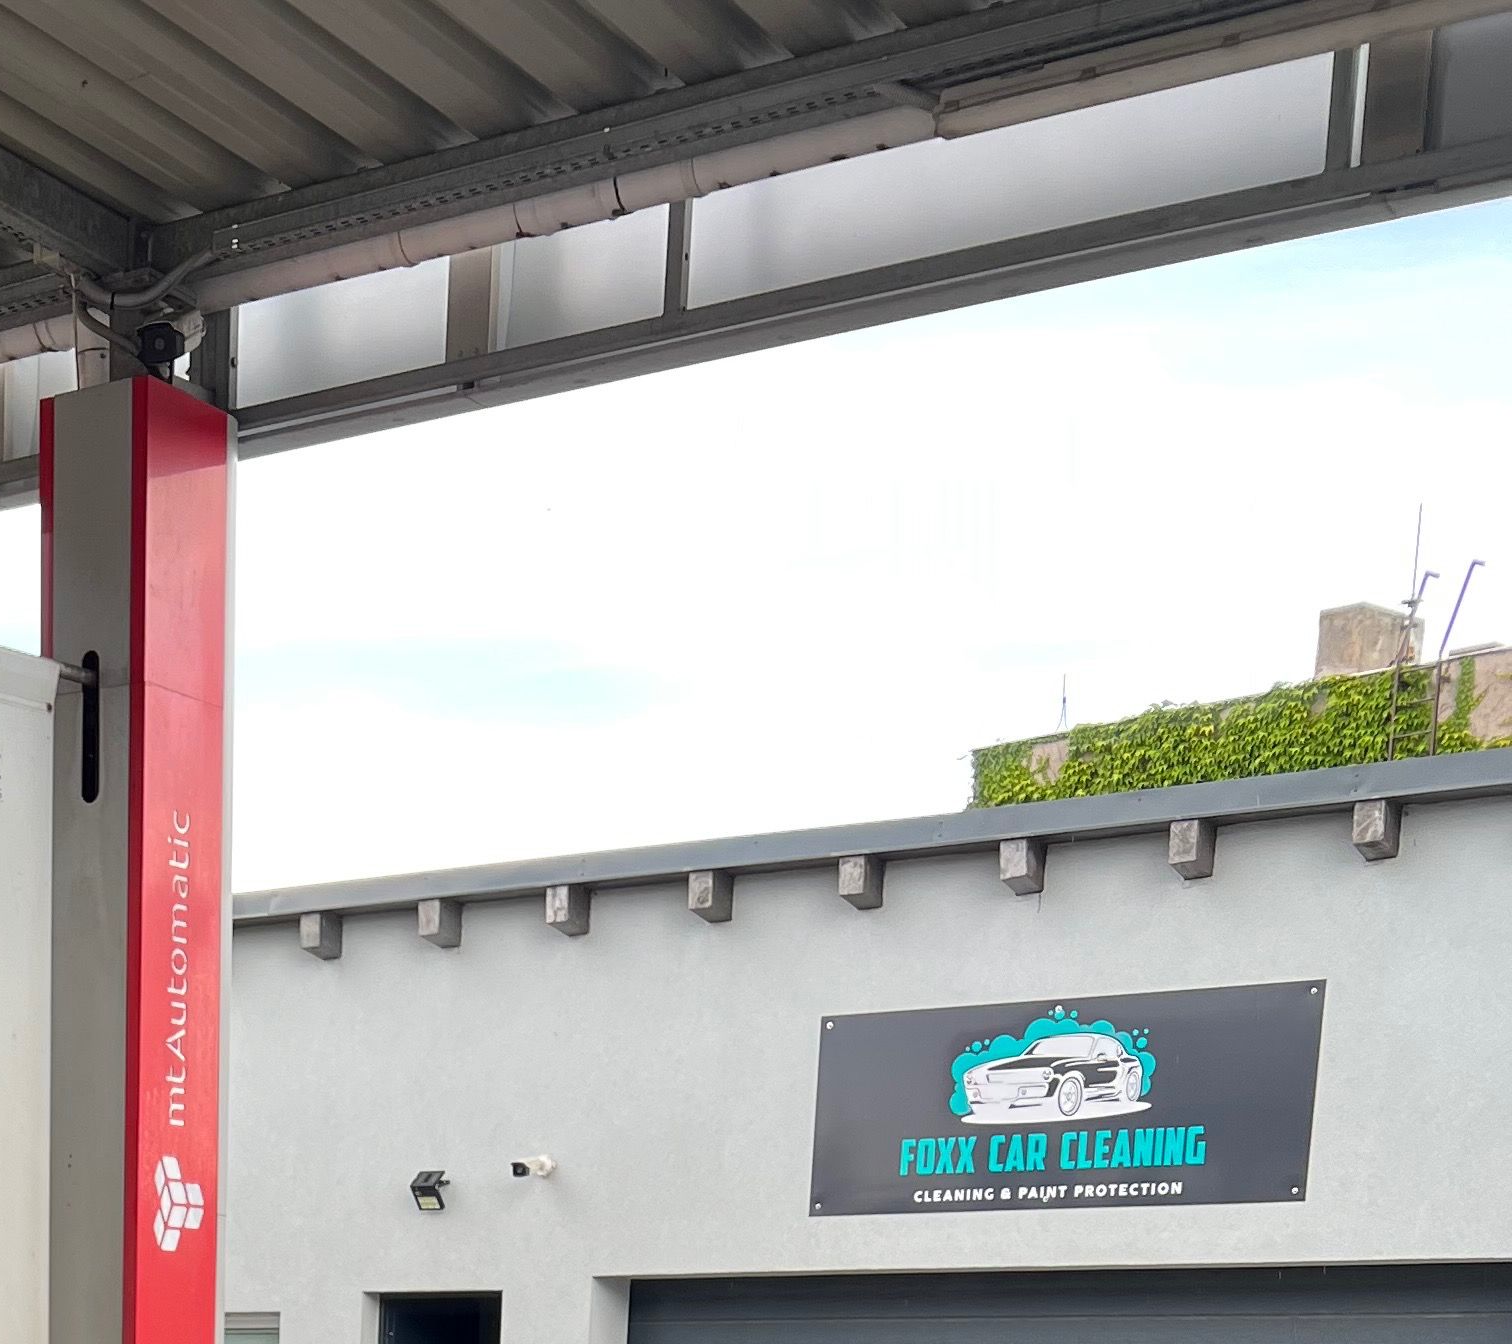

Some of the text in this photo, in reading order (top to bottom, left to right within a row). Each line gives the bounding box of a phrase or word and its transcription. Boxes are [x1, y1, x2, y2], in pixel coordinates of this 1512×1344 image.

[165, 810, 191, 1127] mtAutomatic
[898, 1125, 1207, 1176] FOXX CAR CLEANING
[913, 1181, 1183, 1203] CLEANING & PAINT PROTECTION
